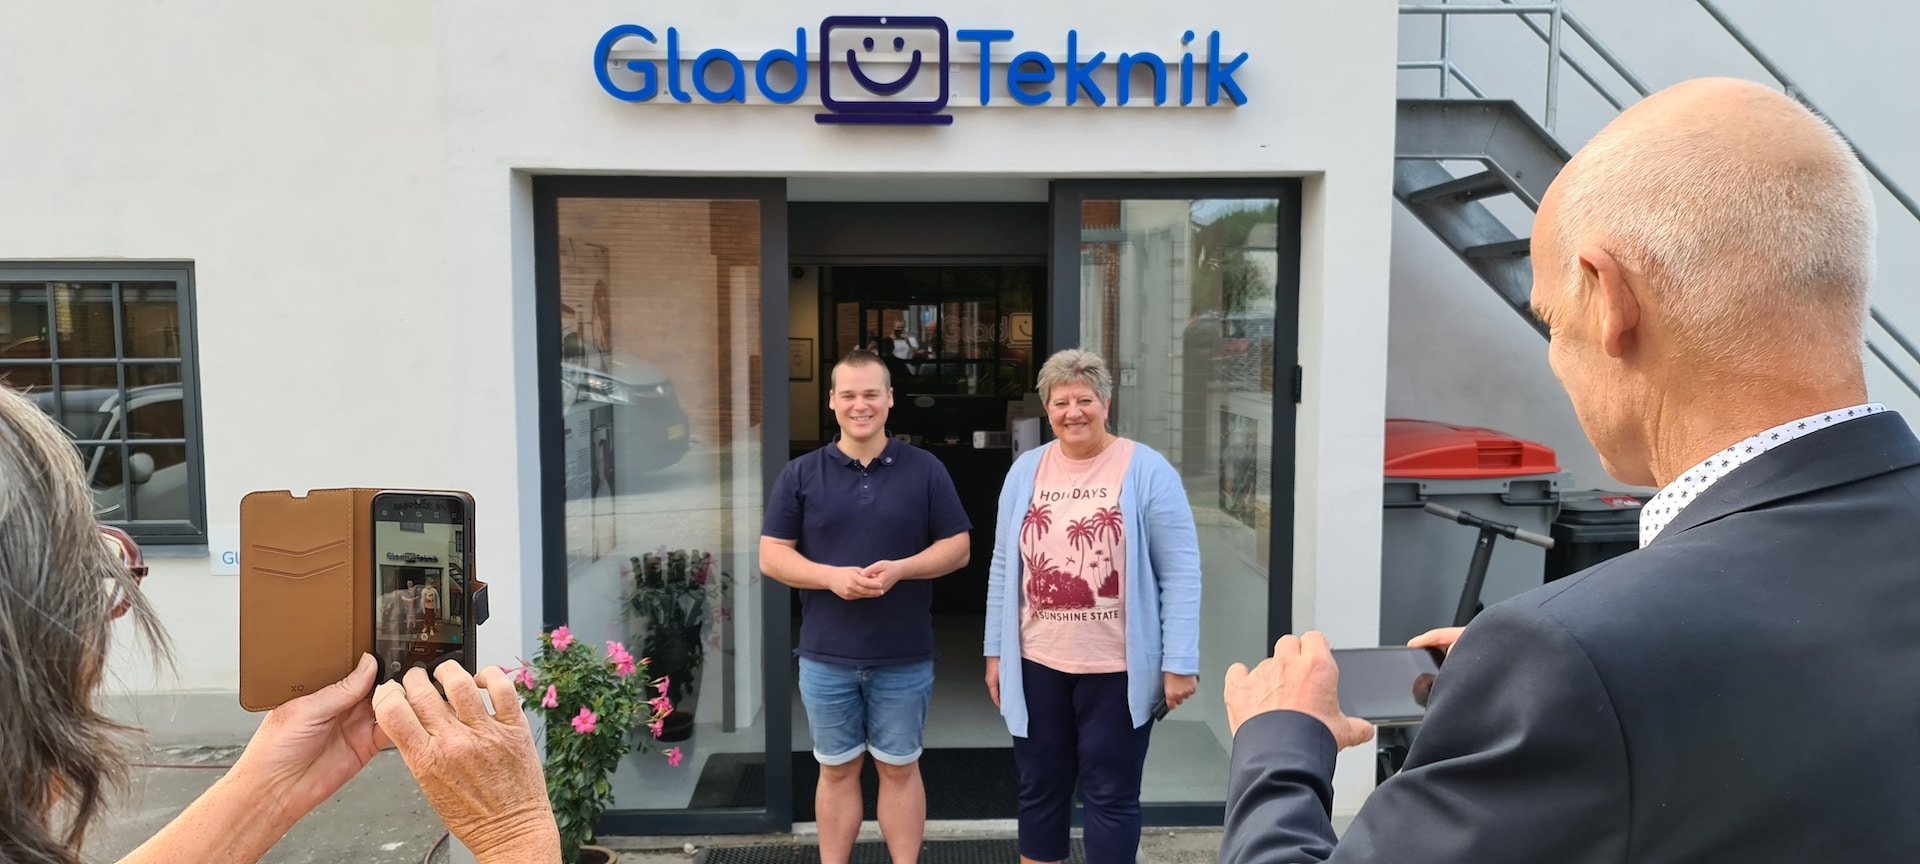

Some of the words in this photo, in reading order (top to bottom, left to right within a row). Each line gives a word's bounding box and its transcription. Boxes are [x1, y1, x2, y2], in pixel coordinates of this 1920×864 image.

[594, 23, 808, 105] Glad
[956, 29, 1249, 107] Teknik
[942, 315, 1009, 342] Glad
[1038, 611, 1087, 622] SUNSHINE
[1090, 609, 1119, 621] STATE
[291, 684, 305, 693] XQ
